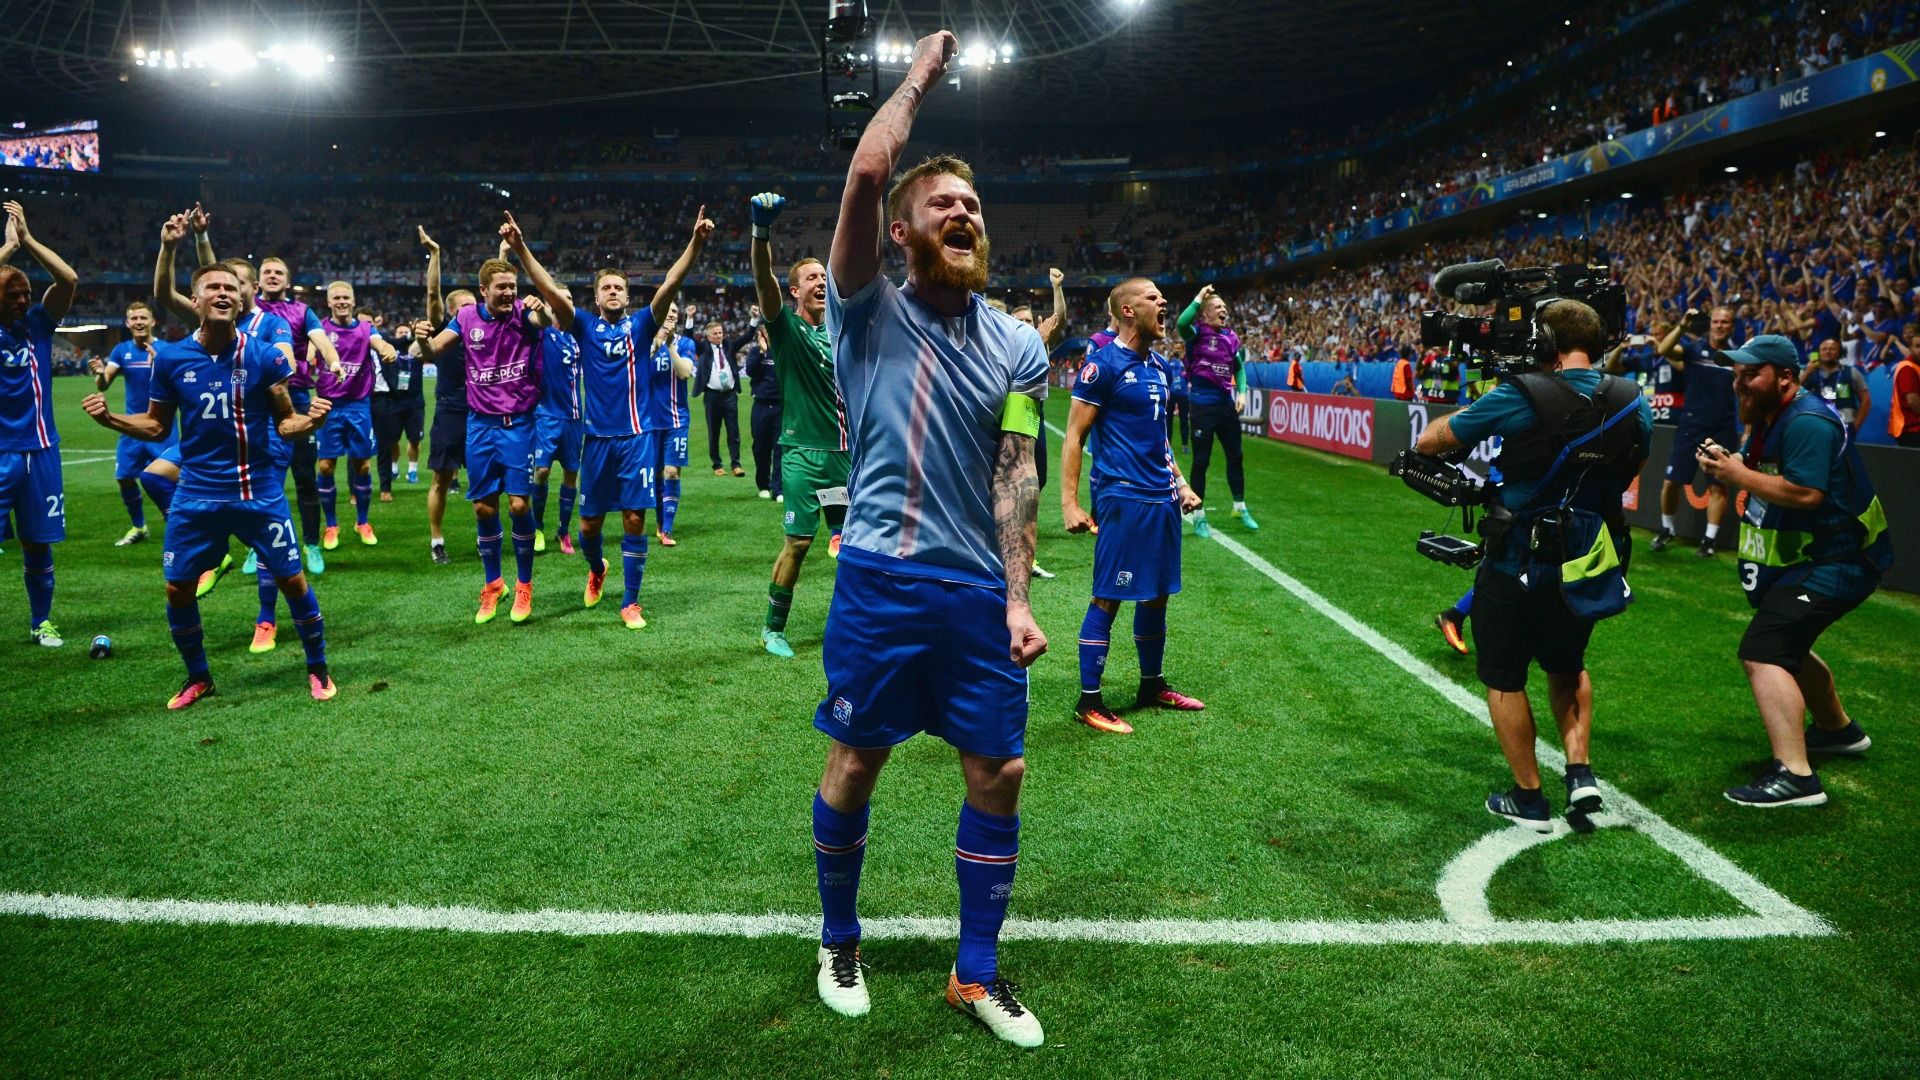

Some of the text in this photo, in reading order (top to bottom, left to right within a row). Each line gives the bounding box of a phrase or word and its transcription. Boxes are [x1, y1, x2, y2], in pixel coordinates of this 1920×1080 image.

[1780, 86, 1809, 110] NICE
[2, 347, 29, 367] 22
[603, 341, 626, 358] 14
[480, 364, 526, 382] RESPECT
[655, 357, 670, 372] 15
[200, 392, 229, 419] 21
[1149, 394, 1160, 421] 7
[1290, 401, 1310, 436] KIA
[1312, 405, 1372, 449] MOTORS
[673, 437, 688, 452] 15
[268, 519, 296, 548] 21
[1741, 563, 1759, 592] 3
